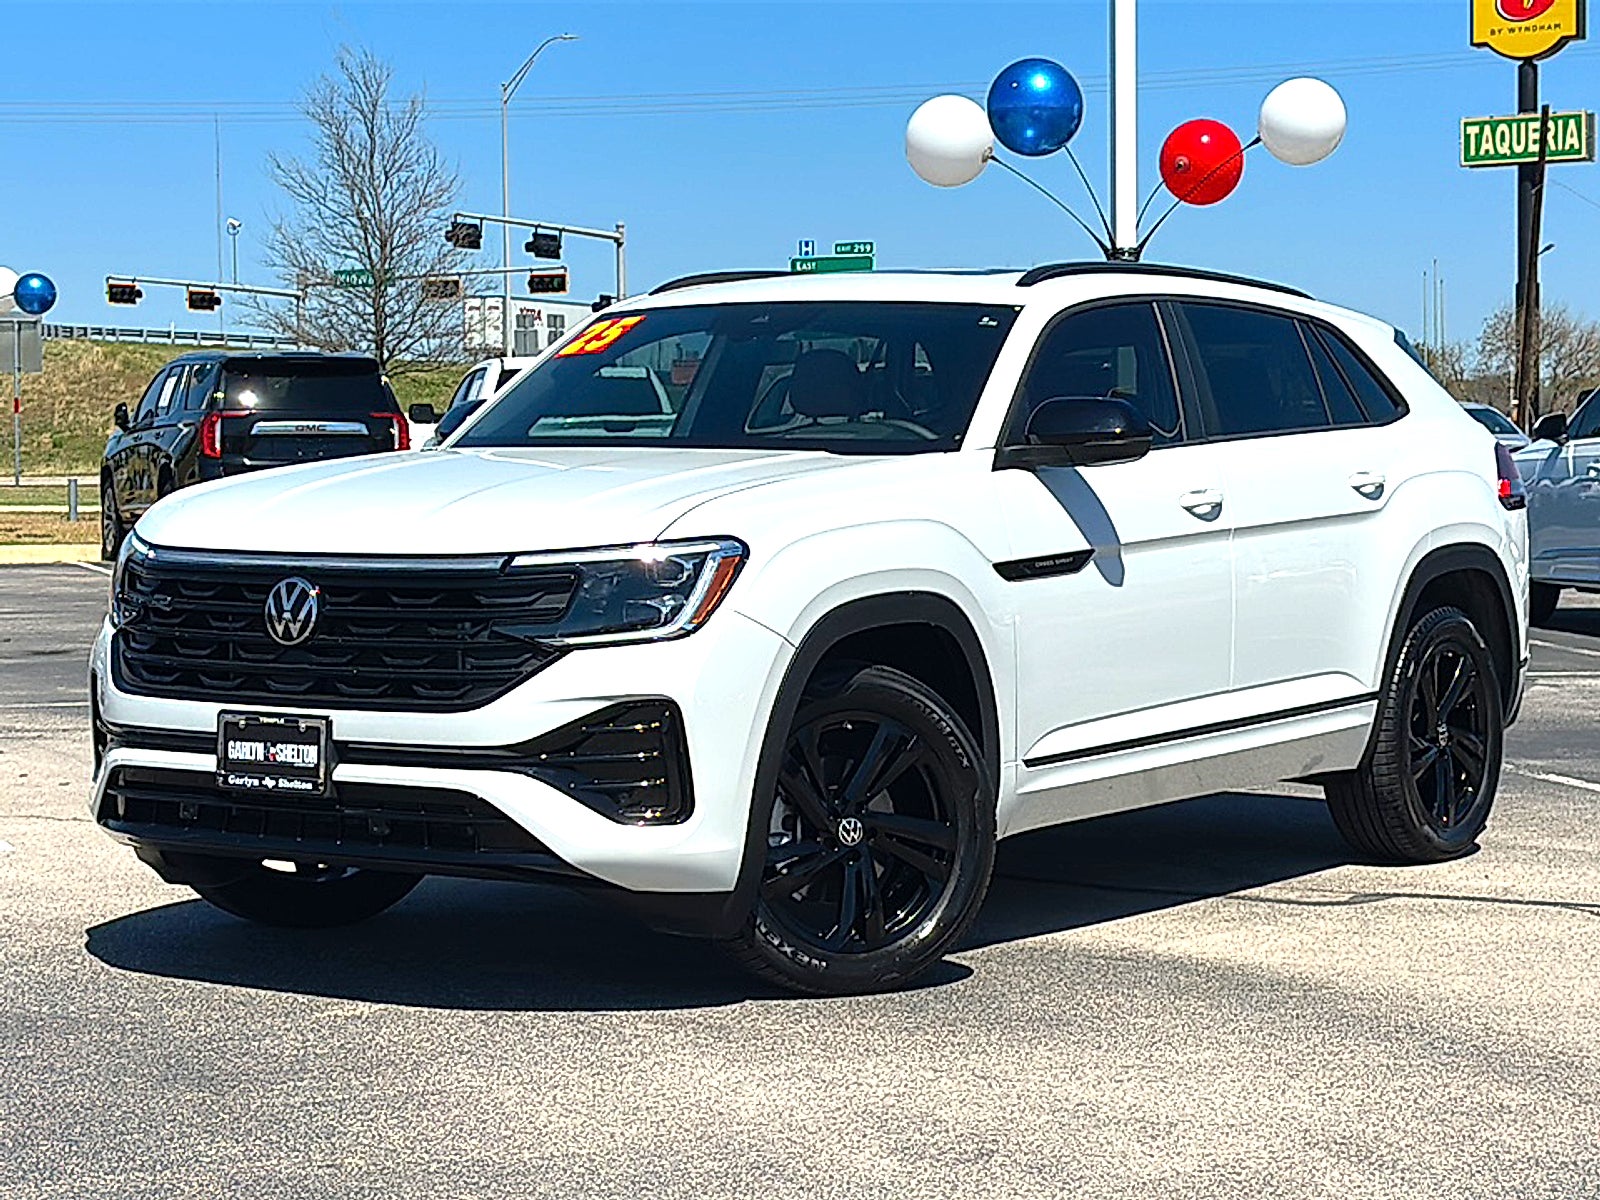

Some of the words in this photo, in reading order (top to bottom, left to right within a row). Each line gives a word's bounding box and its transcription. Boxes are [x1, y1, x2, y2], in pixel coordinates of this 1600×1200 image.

[1490, 28, 1503, 36] BY
[1508, 23, 1561, 34] WYNDHAM
[1466, 118, 1580, 157] TAQUERIA
[853, 243, 871, 253] 299
[796, 261, 817, 271] EAST
[553, 315, 647, 359] 25
[295, 424, 327, 432] GMC
[228, 740, 264, 762] GARLYN
[276, 743, 318, 764] SHELTON
[228, 775, 259, 788] Garlyn
[278, 778, 313, 790] Shelton
